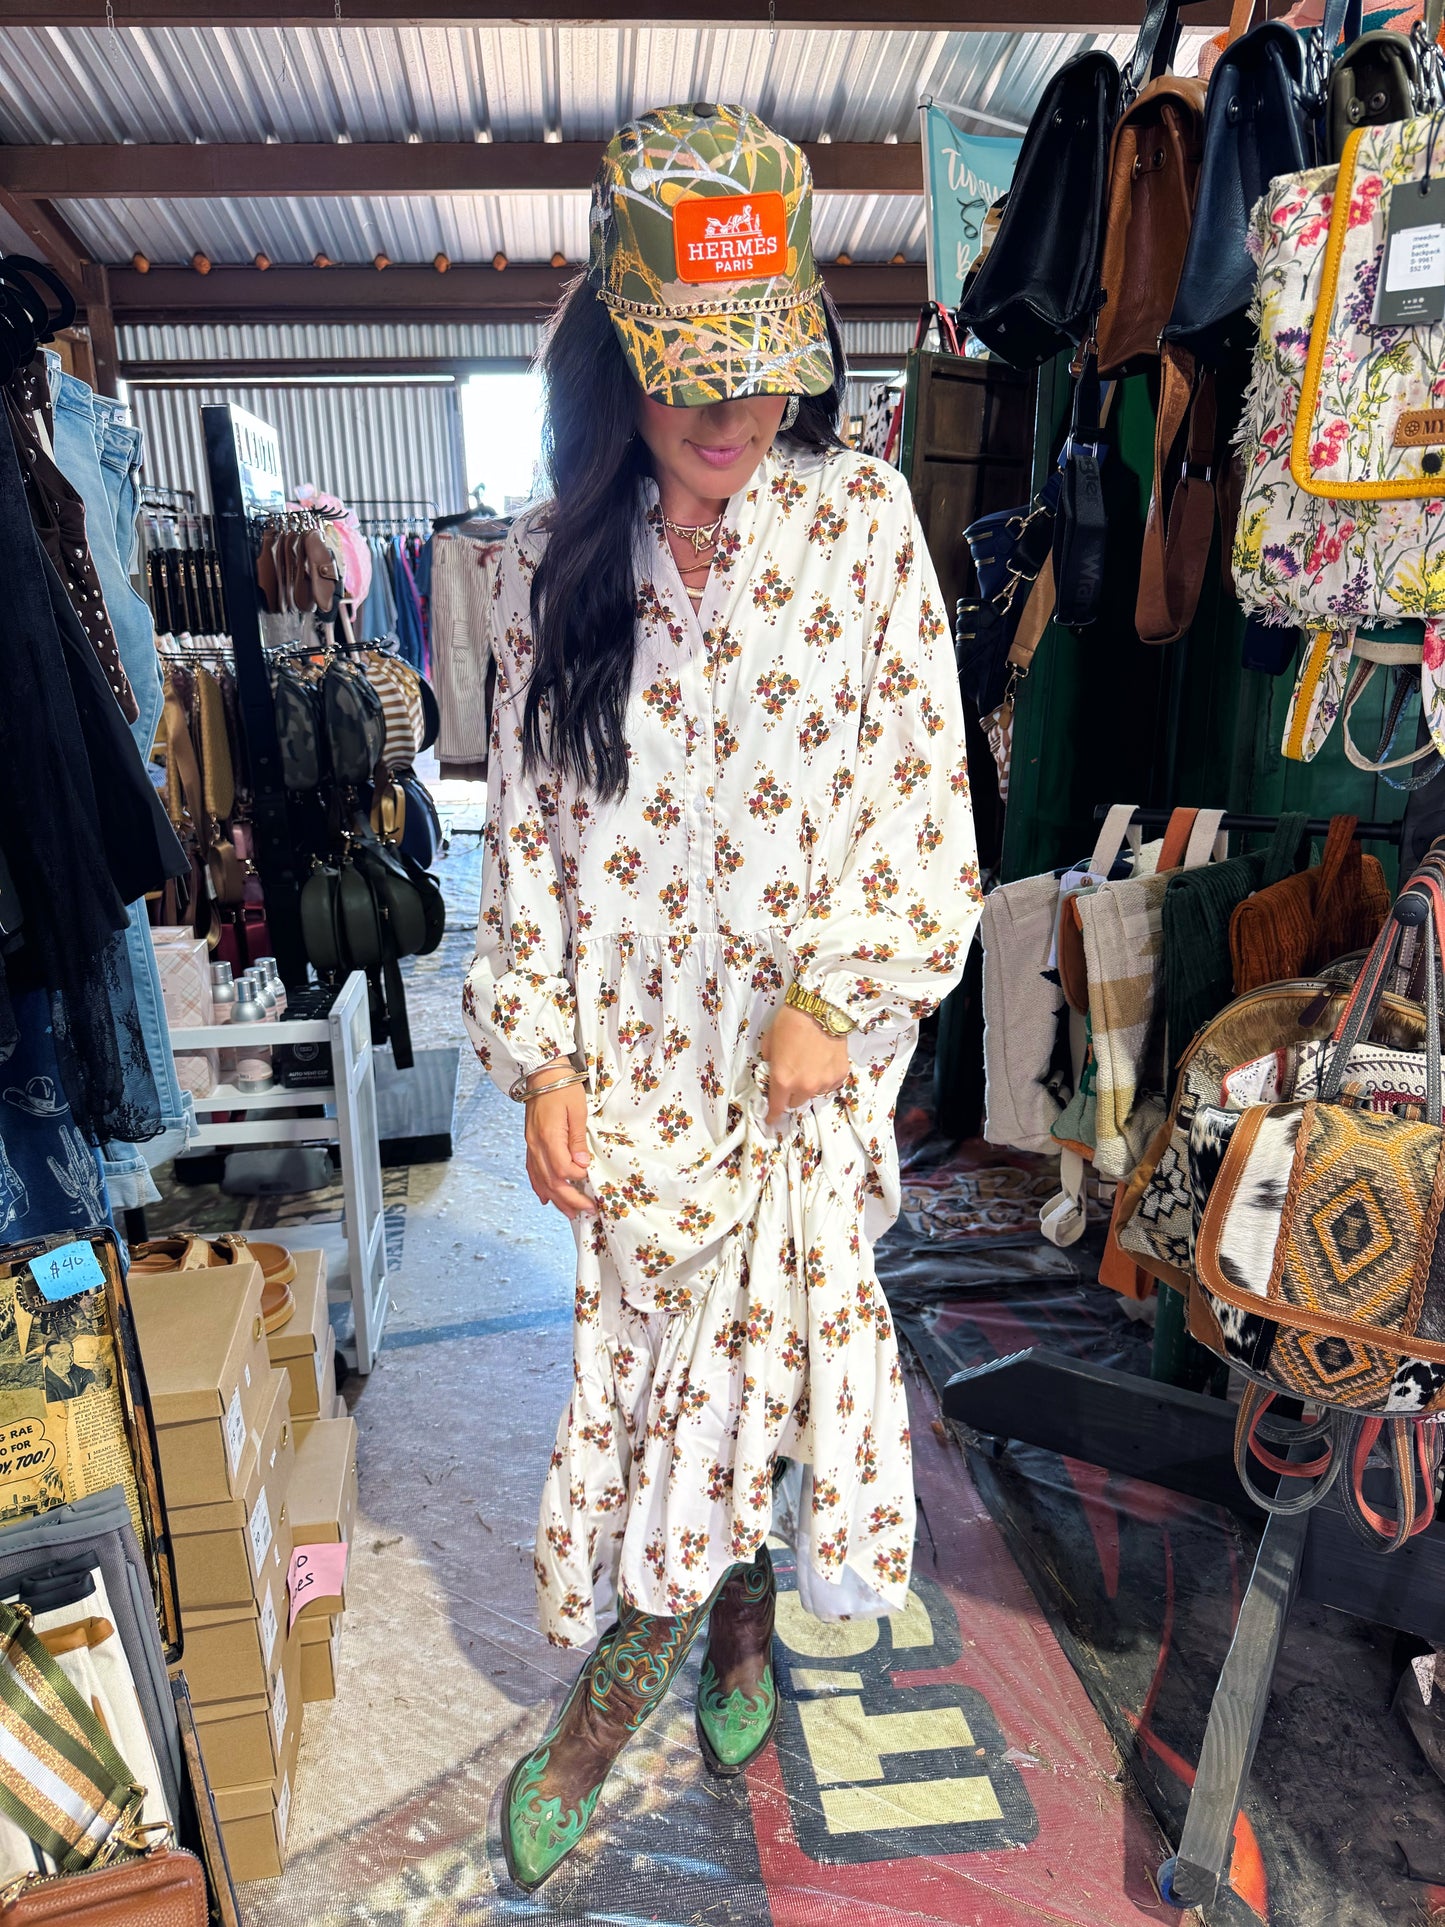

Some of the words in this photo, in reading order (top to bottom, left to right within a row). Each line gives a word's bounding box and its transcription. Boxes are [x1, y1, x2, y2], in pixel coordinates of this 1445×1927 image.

[715, 259, 754, 273] PARIS
[10, 1425, 33, 1438] RAE
[10, 1440, 31, 1452] FOR
[16, 1447, 50, 1470] TOO!
